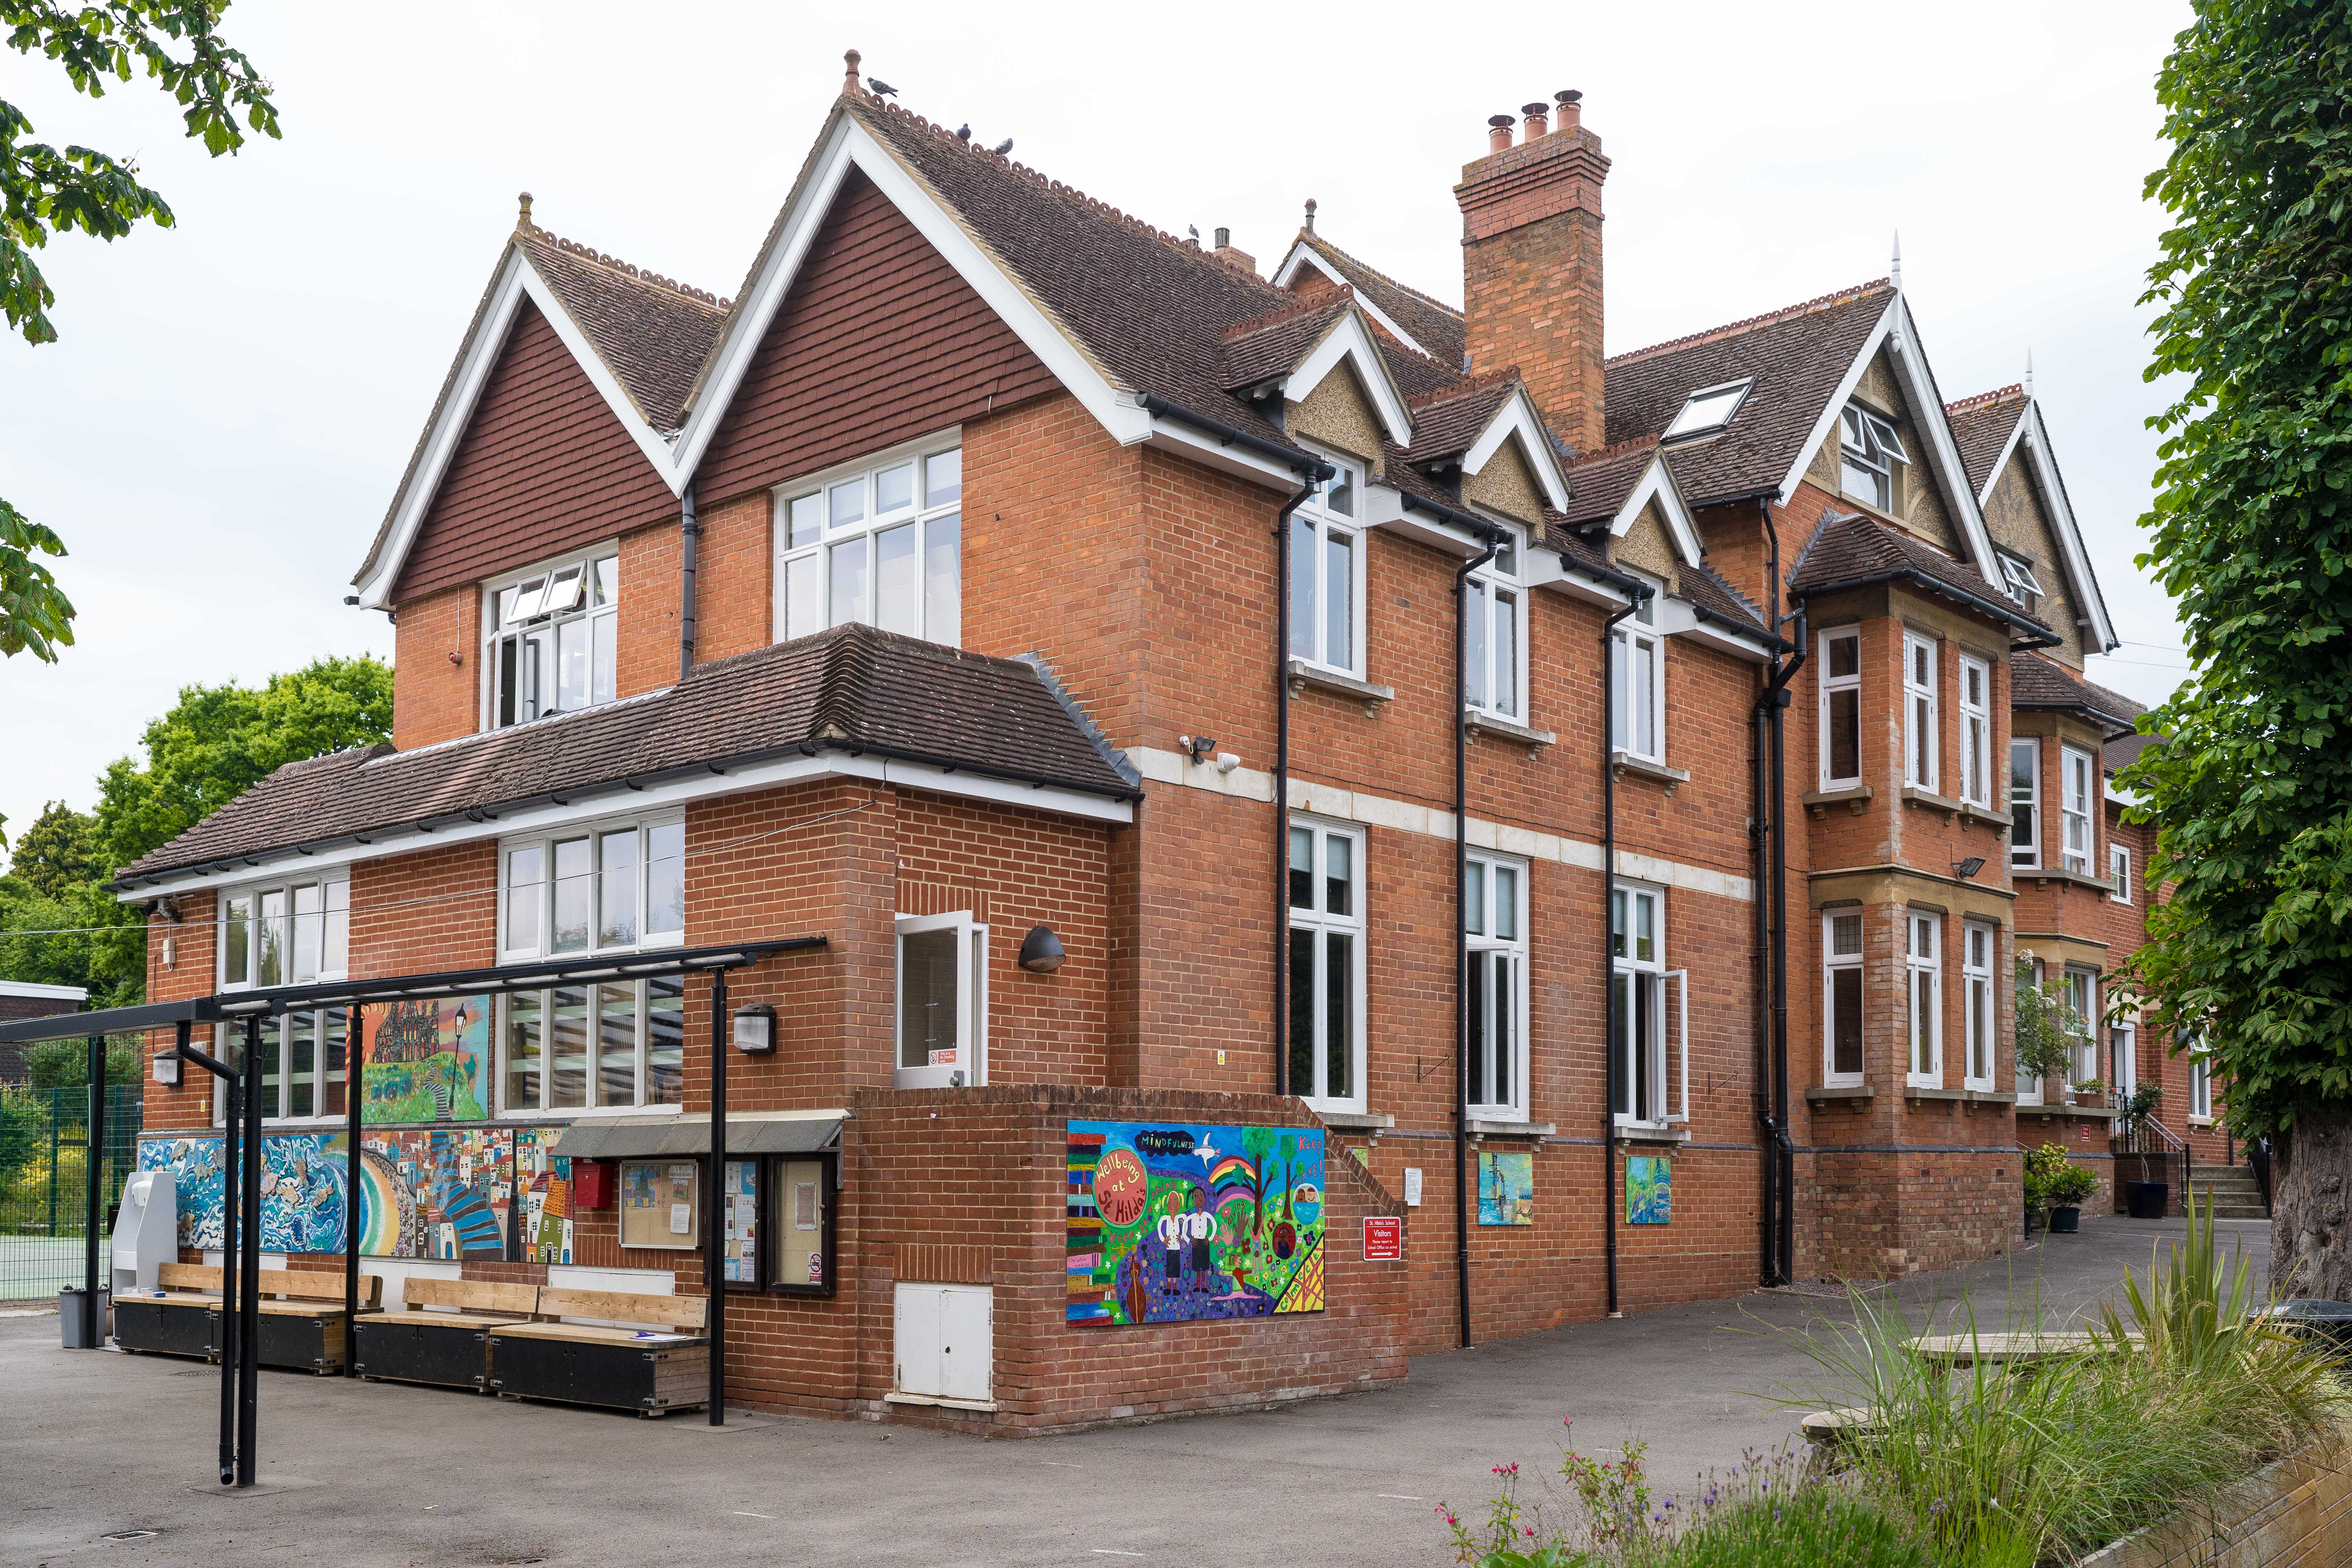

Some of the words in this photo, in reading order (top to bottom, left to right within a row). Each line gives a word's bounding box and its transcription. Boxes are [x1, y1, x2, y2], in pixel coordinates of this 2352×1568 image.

[1298, 1135, 1322, 1155] Keep
[1096, 1153, 1140, 1184] Wellbeing
[1112, 1180, 1125, 1192] at
[1098, 1190, 1112, 1214] St
[1115, 1188, 1146, 1223] Hilda's
